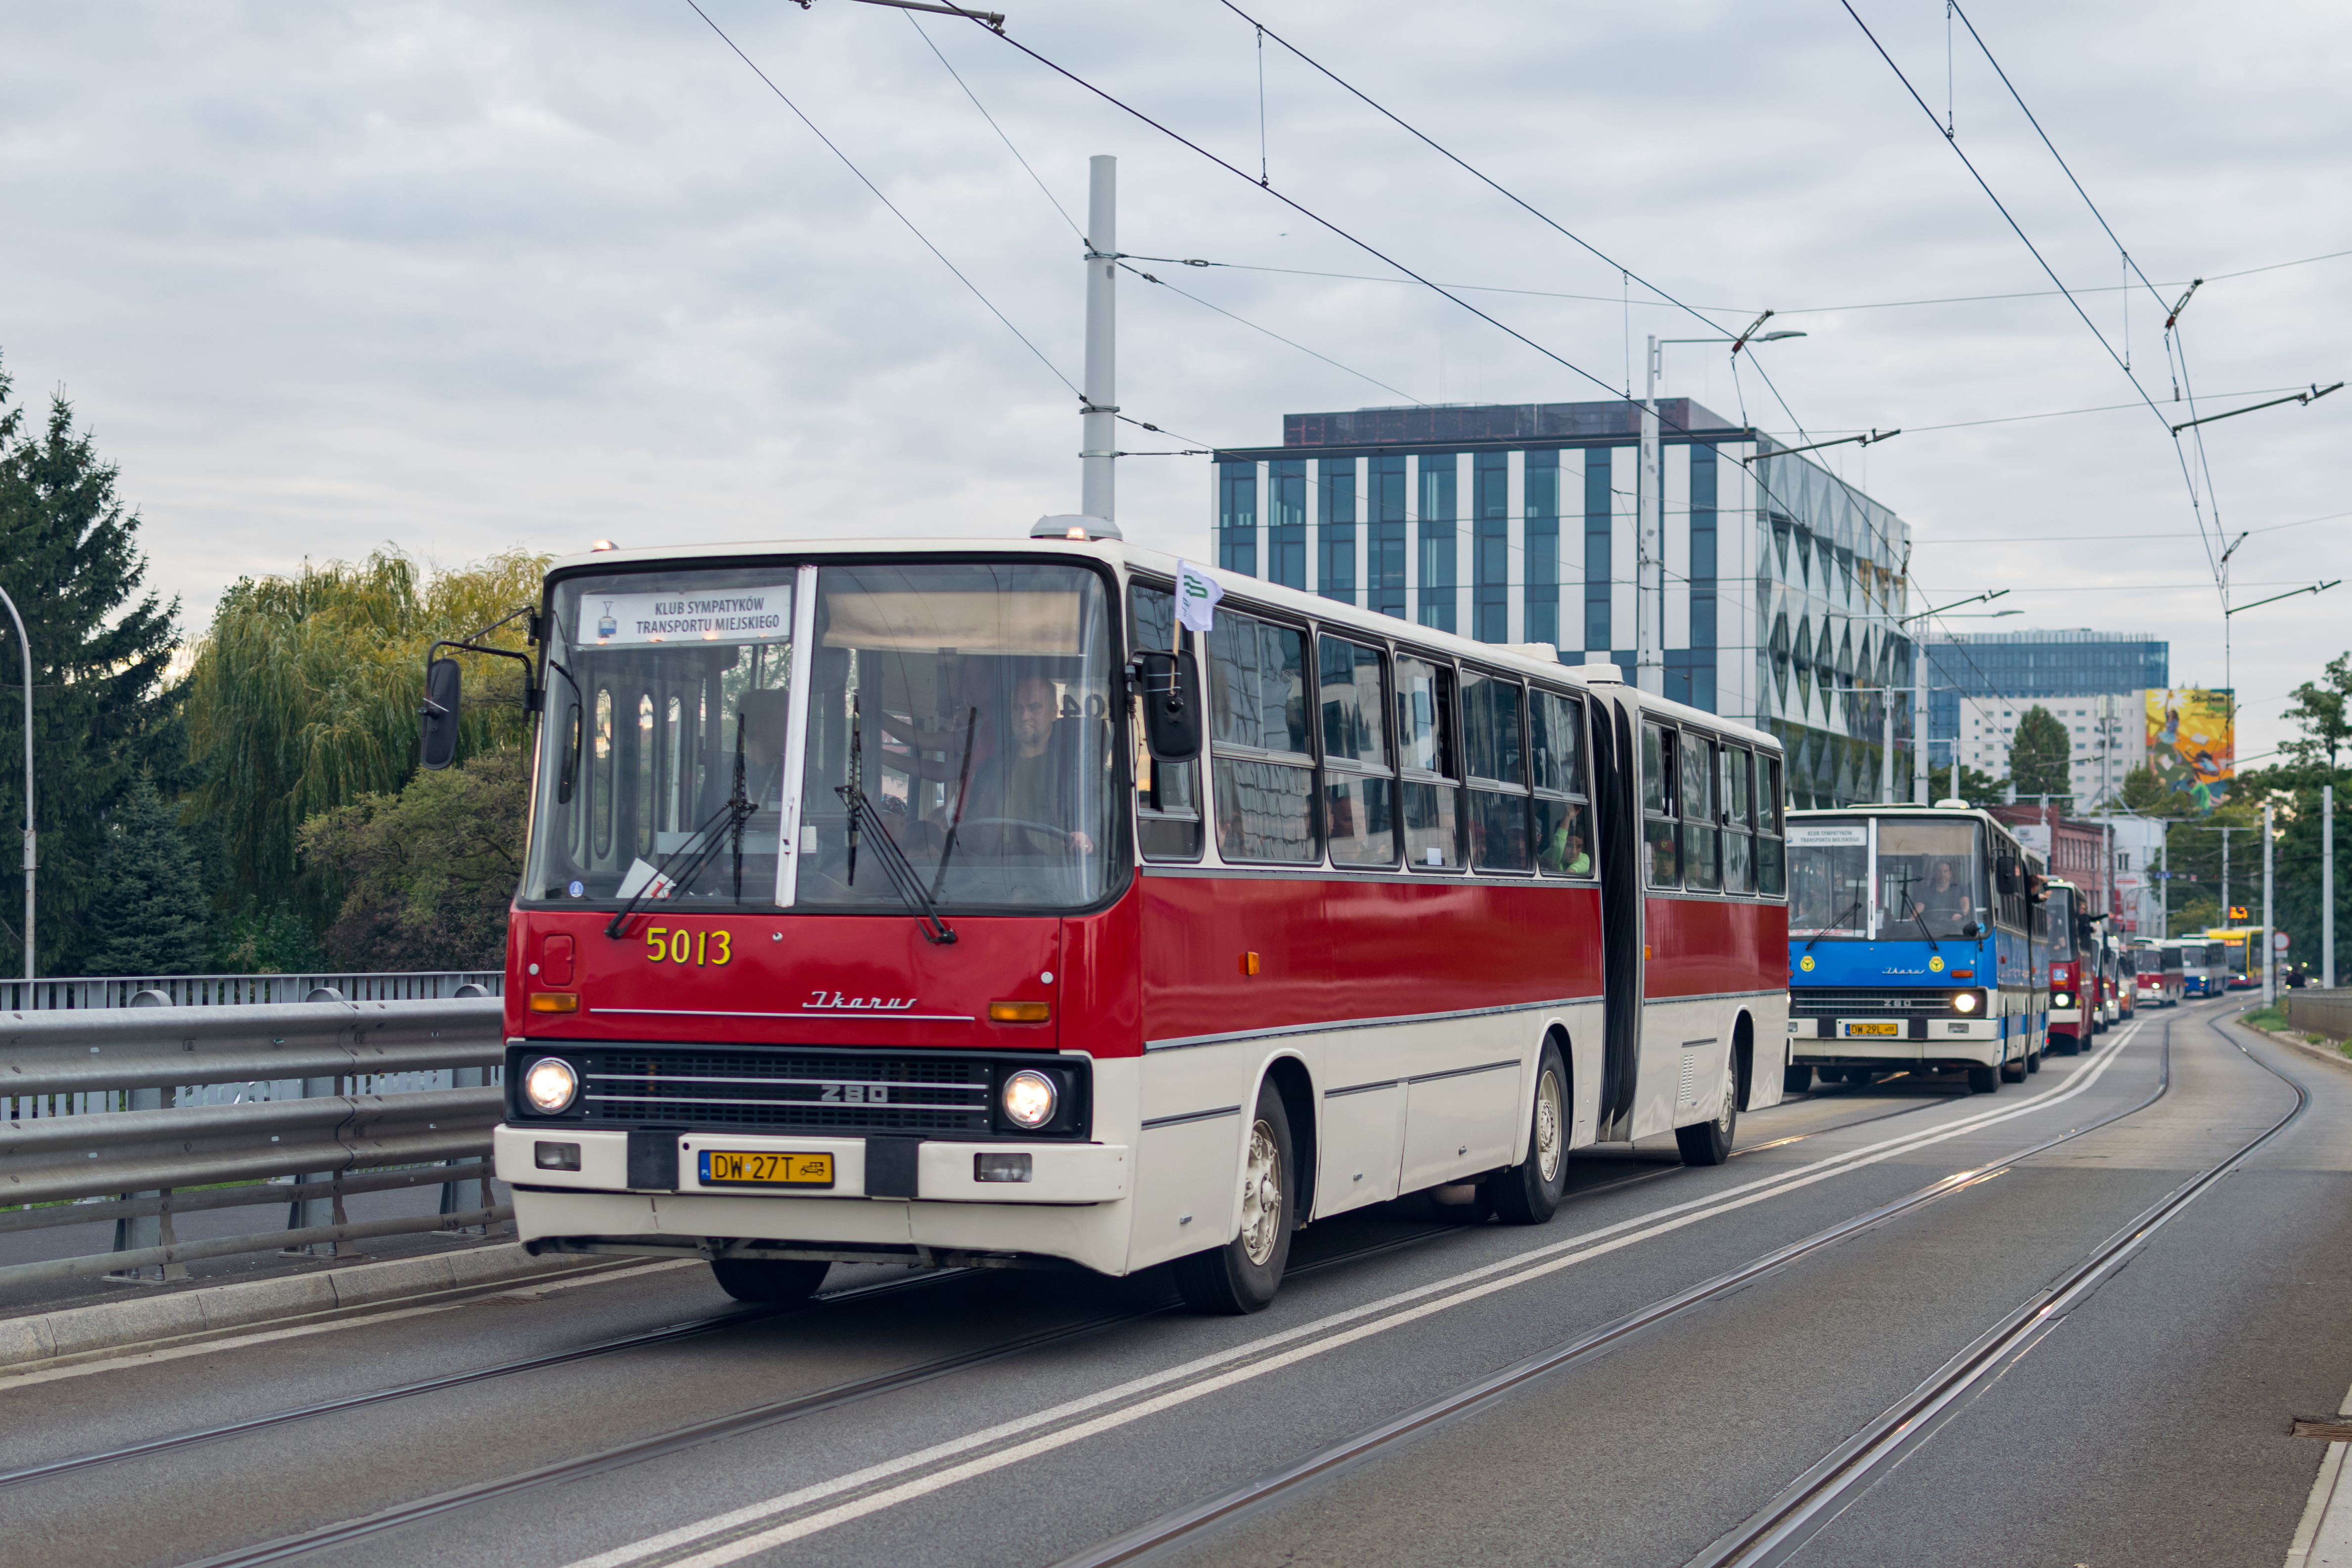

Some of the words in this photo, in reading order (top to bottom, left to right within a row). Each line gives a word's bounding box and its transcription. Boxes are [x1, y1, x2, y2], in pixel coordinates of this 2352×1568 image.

[655, 601, 685, 616] KLUB
[688, 595, 764, 615] SYMPATYKÓW
[637, 618, 712, 634] TRANSPORTU
[715, 614, 780, 632] MIEJSKIEGO
[647, 927, 732, 966] 5013
[802, 991, 917, 1009] Ikarus
[1851, 1025, 1863, 1034] DW
[1866, 1025, 1882, 1034] 29L
[715, 1155, 743, 1179] DW
[753, 1156, 794, 1180] 27T
